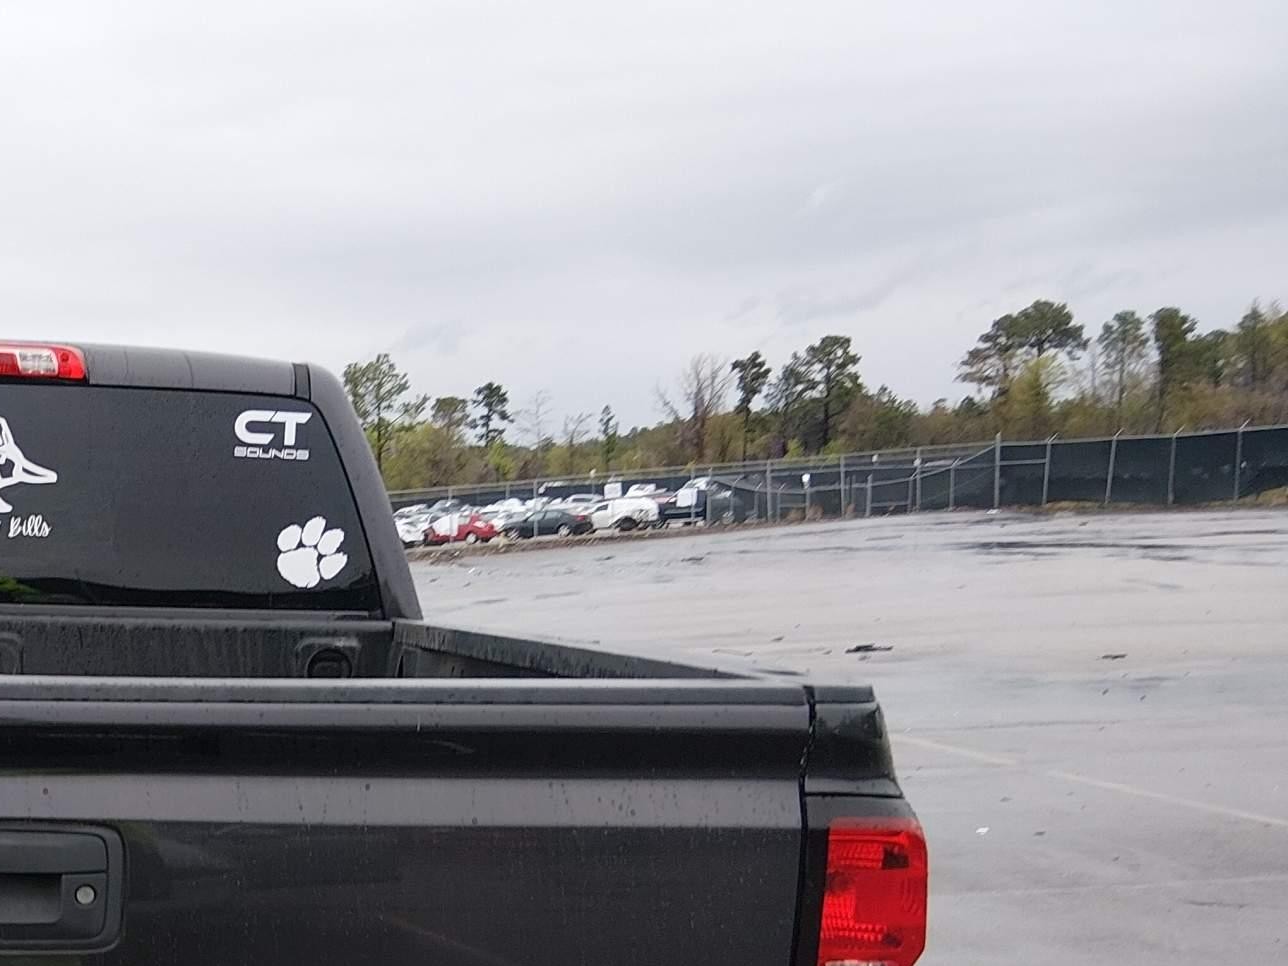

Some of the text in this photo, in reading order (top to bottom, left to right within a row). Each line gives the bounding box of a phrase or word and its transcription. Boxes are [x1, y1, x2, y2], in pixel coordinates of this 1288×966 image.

[234, 410, 312, 446] CT
[234, 446, 310, 460] SOUNDS
[8, 514, 52, 538] Bills
